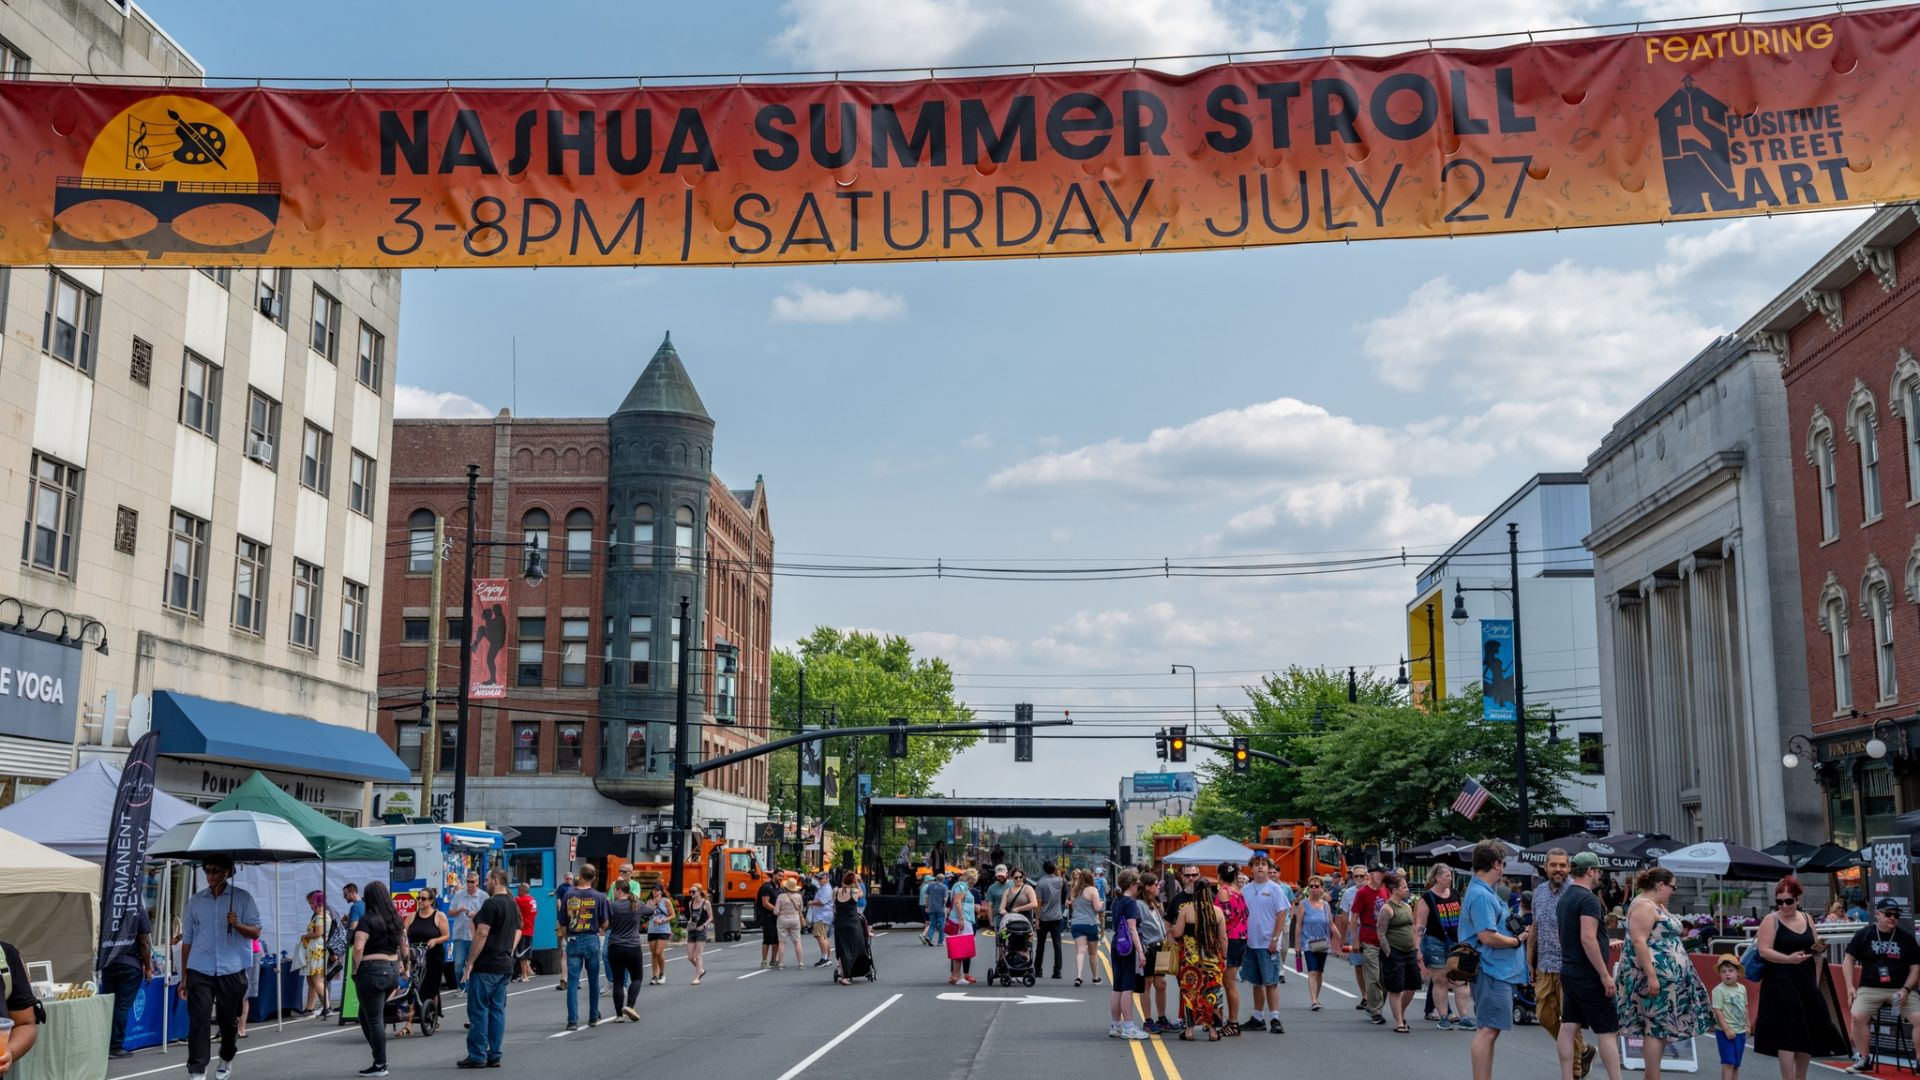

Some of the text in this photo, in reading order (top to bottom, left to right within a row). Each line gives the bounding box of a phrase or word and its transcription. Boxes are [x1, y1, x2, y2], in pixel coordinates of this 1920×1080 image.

[379, 108, 720, 176] NASHUA
[1205, 67, 1537, 153] STROLL
[1726, 104, 1842, 138] POSITIVE
[1731, 130, 1844, 165] STREET
[1738, 157, 1850, 208] ART
[376, 195, 646, 257] 3-8PM
[728, 178, 1170, 255] SATURDAY,
[1205, 163, 1404, 238] JULY
[1440, 154, 1534, 224] 27
[474, 581, 505, 596] Enjoy
[1482, 622, 1511, 635] Enjoy
[15, 669, 64, 705] YOGA
[1521, 852, 1546, 863] WHIT
[1612, 857, 1638, 868] CLAW
[1875, 843, 1904, 860] SCHOOL
[111, 811, 132, 932] PERMANENT
[392, 899, 416, 909] STOP
